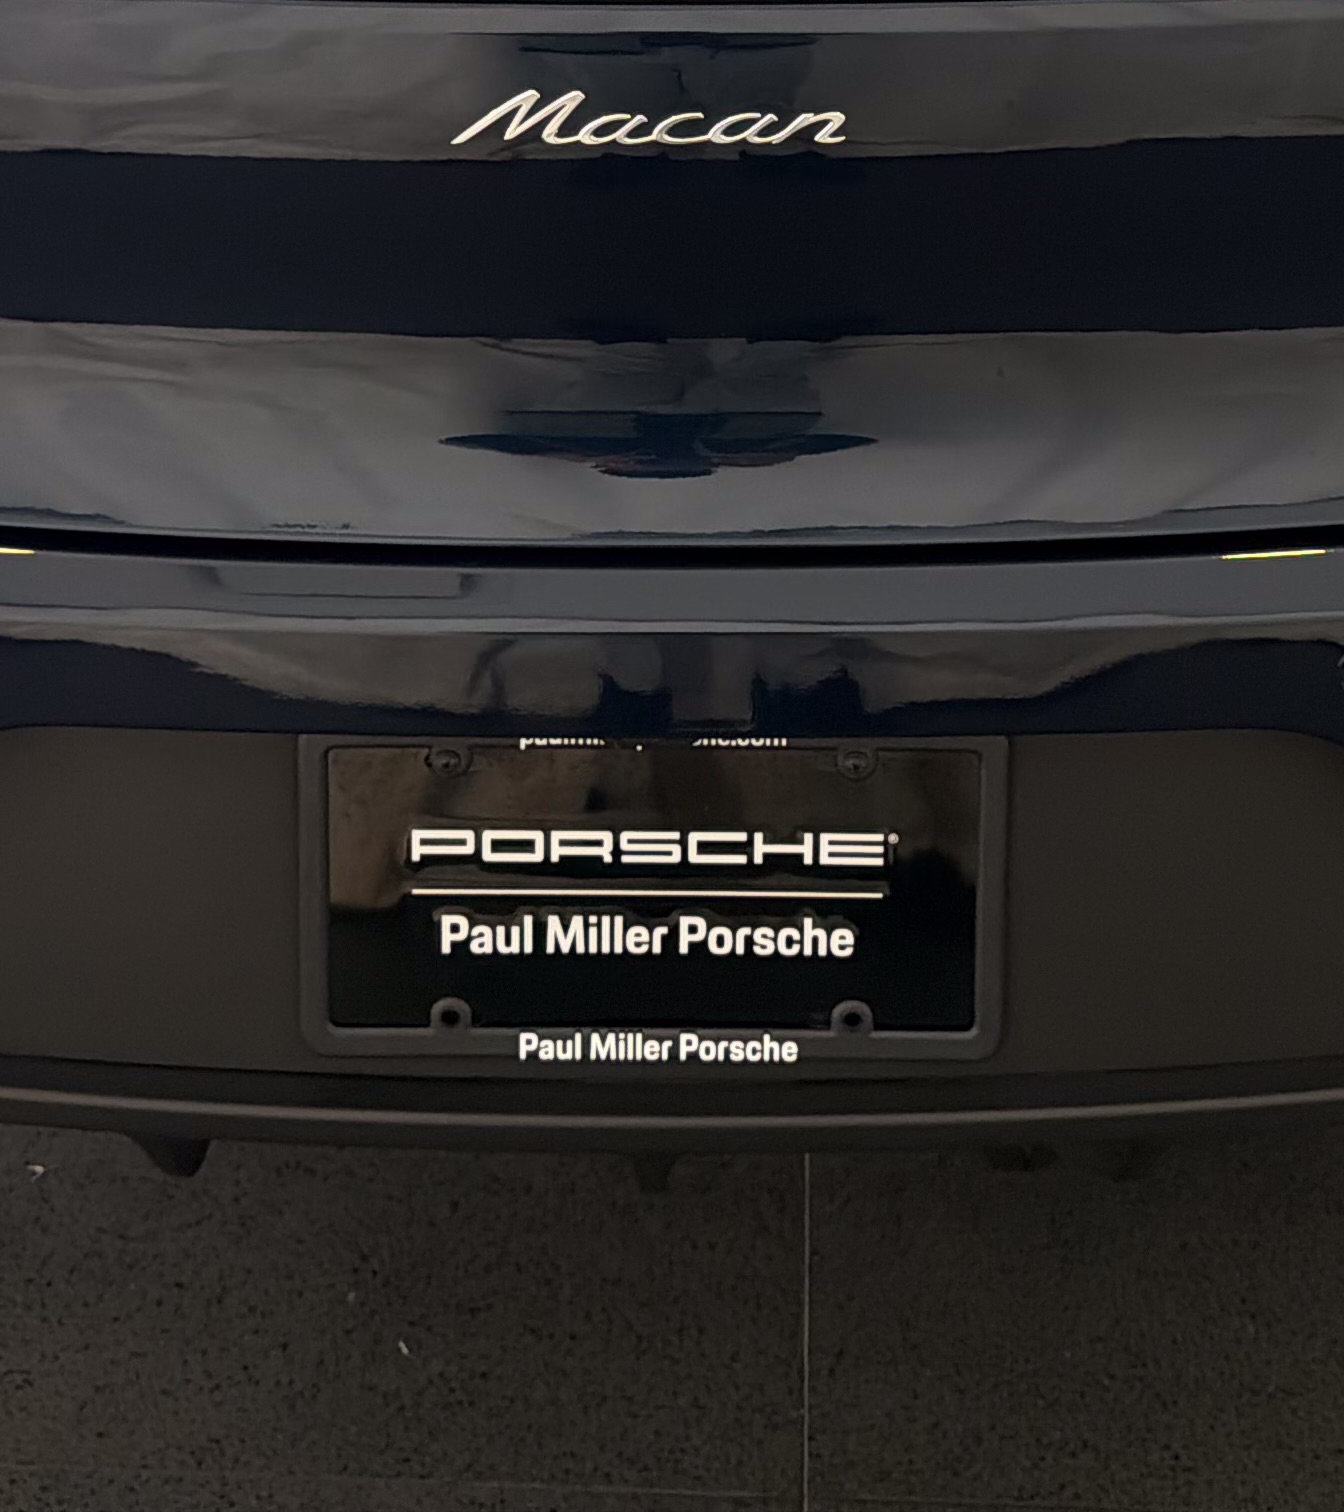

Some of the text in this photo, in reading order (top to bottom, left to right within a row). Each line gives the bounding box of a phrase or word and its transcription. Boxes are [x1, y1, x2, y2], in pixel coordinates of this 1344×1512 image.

[450, 88, 848, 147] Macan
[409, 827, 886, 868] PORSCHE
[439, 913, 856, 959] Paul Miller Porsche
[517, 1031, 800, 1064] Paul Miller Porsche
